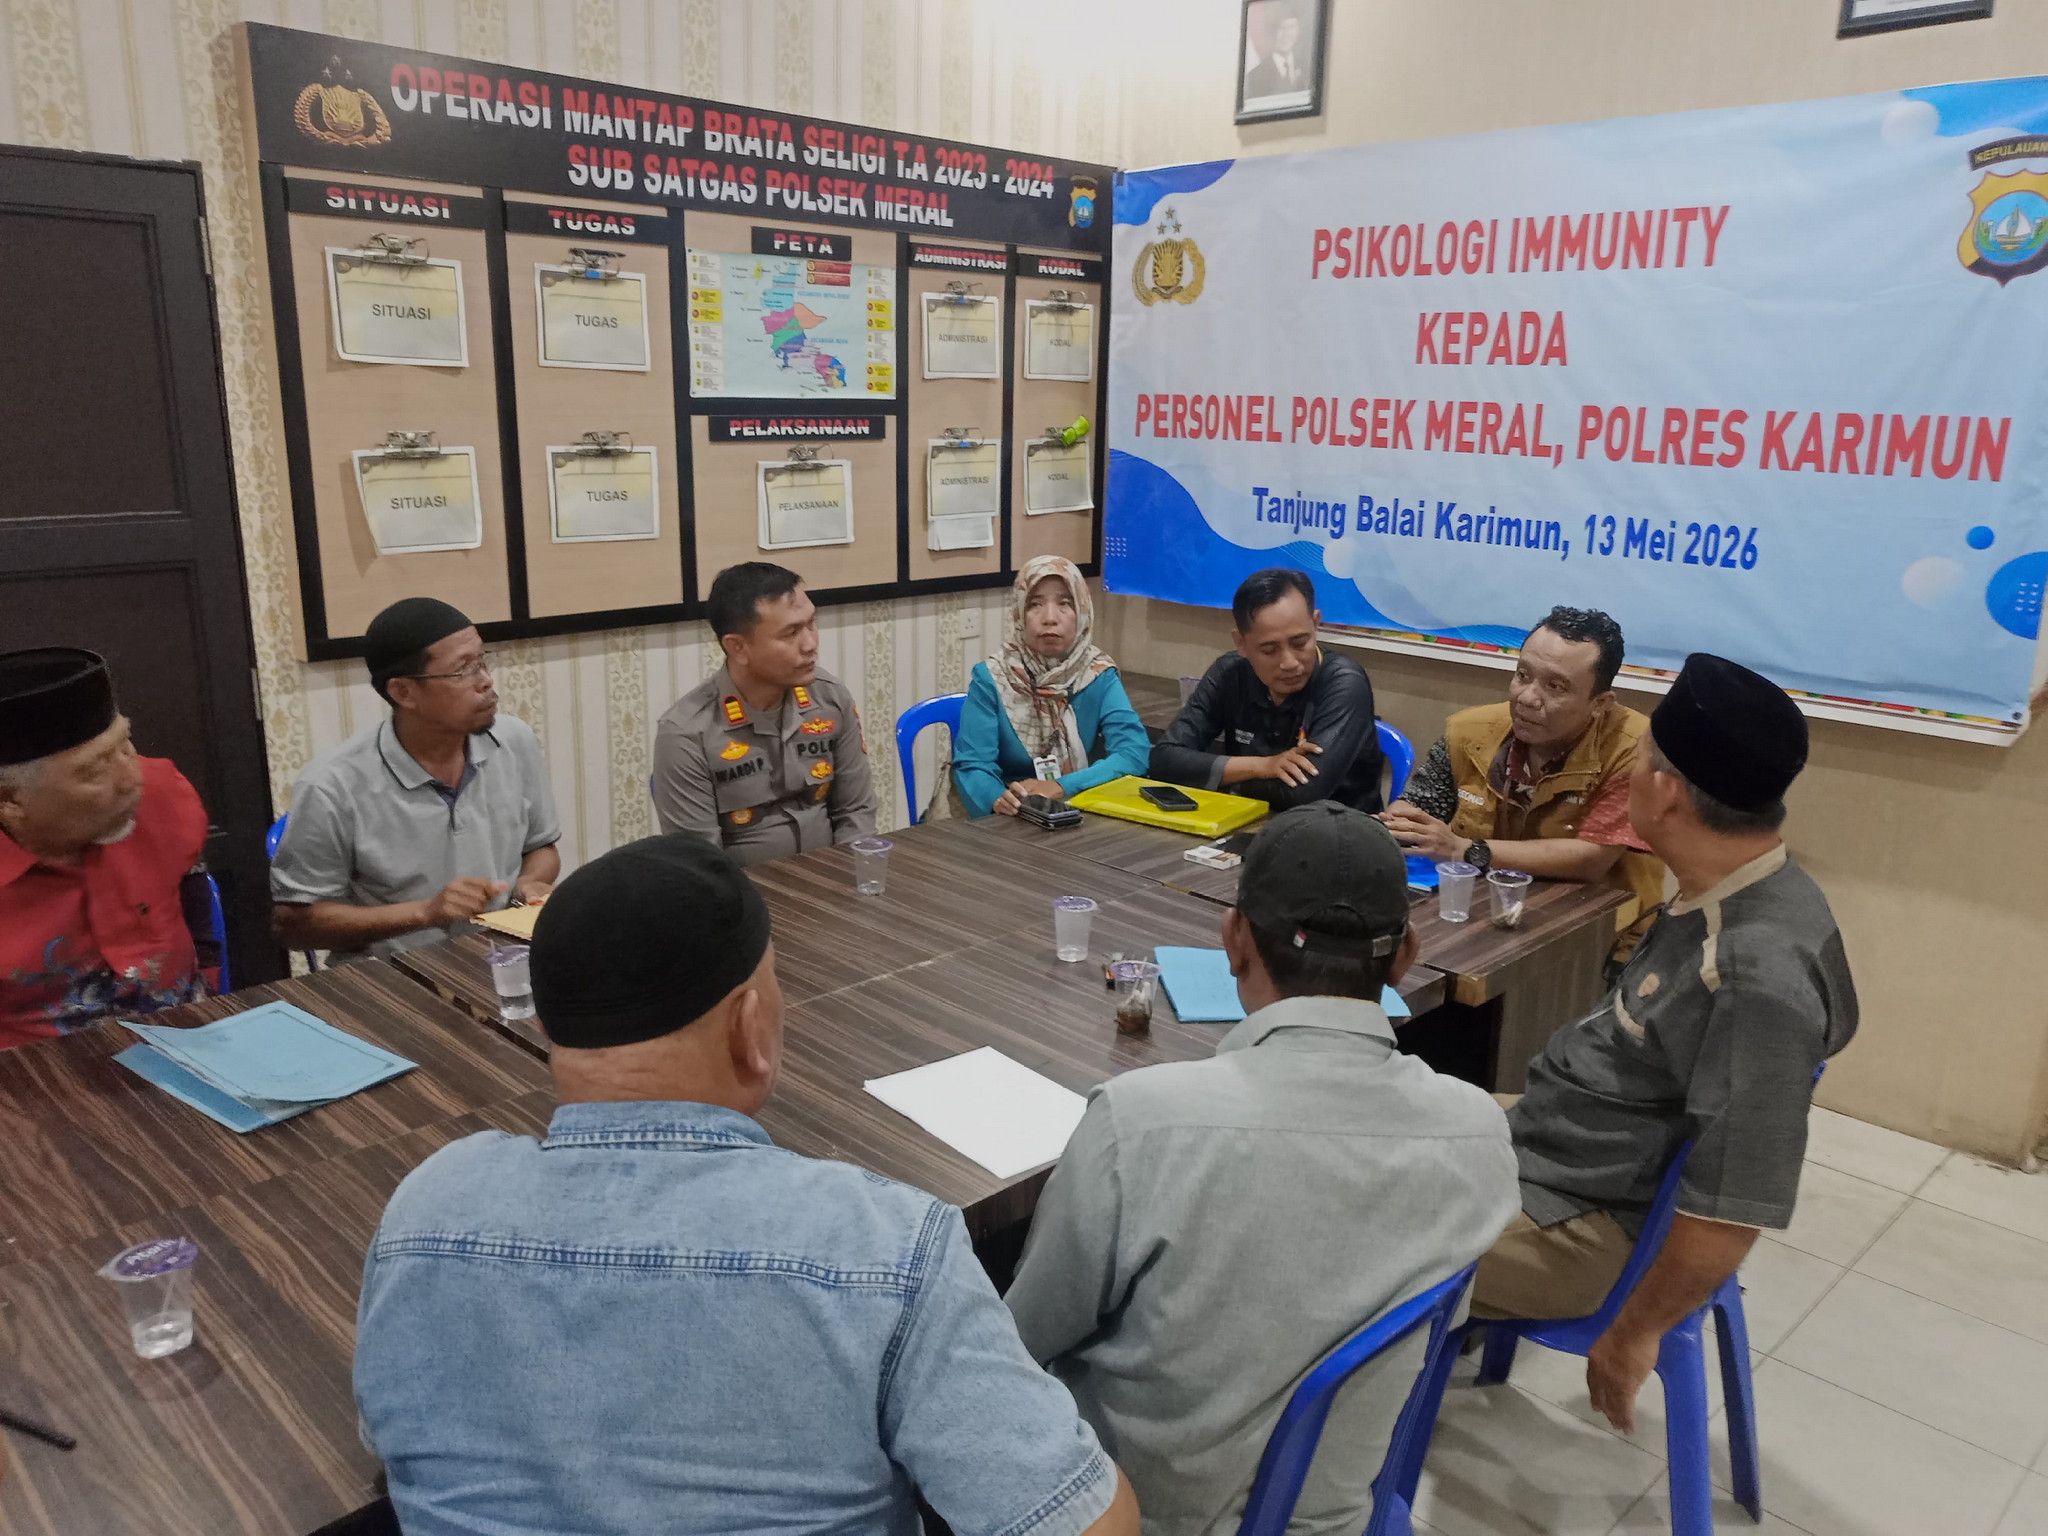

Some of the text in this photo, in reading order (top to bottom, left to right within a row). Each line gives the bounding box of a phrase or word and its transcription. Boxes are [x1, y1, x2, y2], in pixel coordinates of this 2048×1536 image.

[391, 63, 552, 129] OPERASI
[563, 88, 695, 147] MANTAP
[704, 110, 796, 163] BRATA
[802, 124, 886, 173] SELIGI
[894, 141, 928, 181] T.A
[934, 148, 987, 190] 2023
[1004, 158, 1054, 199] 2024
[567, 144, 954, 228] SUB SATGAS POLSEK MERAL
[326, 187, 451, 219] SITUASI
[548, 210, 636, 236] TUGAS
[773, 233, 834, 255] PETA
[1311, 205, 1730, 279] PSIKOLOGI IMMUNITY
[914, 247, 1007, 270] ADMINISTRASI
[1038, 258, 1085, 276] KODAL
[371, 303, 431, 321] SITUASI
[574, 314, 618, 329] TUGAS
[938, 333, 988, 344] ADMINISTRASI
[1415, 311, 1568, 366] KEPADA
[729, 418, 870, 437] PELAKSANAAN
[1135, 394, 2011, 482] PERSONEL POLSEK MERAL, POLRES KARIMUN
[940, 476, 990, 486] ADMINISTRASI
[390, 495, 447, 510] SITUASI
[586, 489, 628, 503] TUGAS
[778, 499, 839, 511] PELAKSANAAN
[1252, 487, 1758, 570] Tanjung Balai Karimun, 13 Mei 2026
